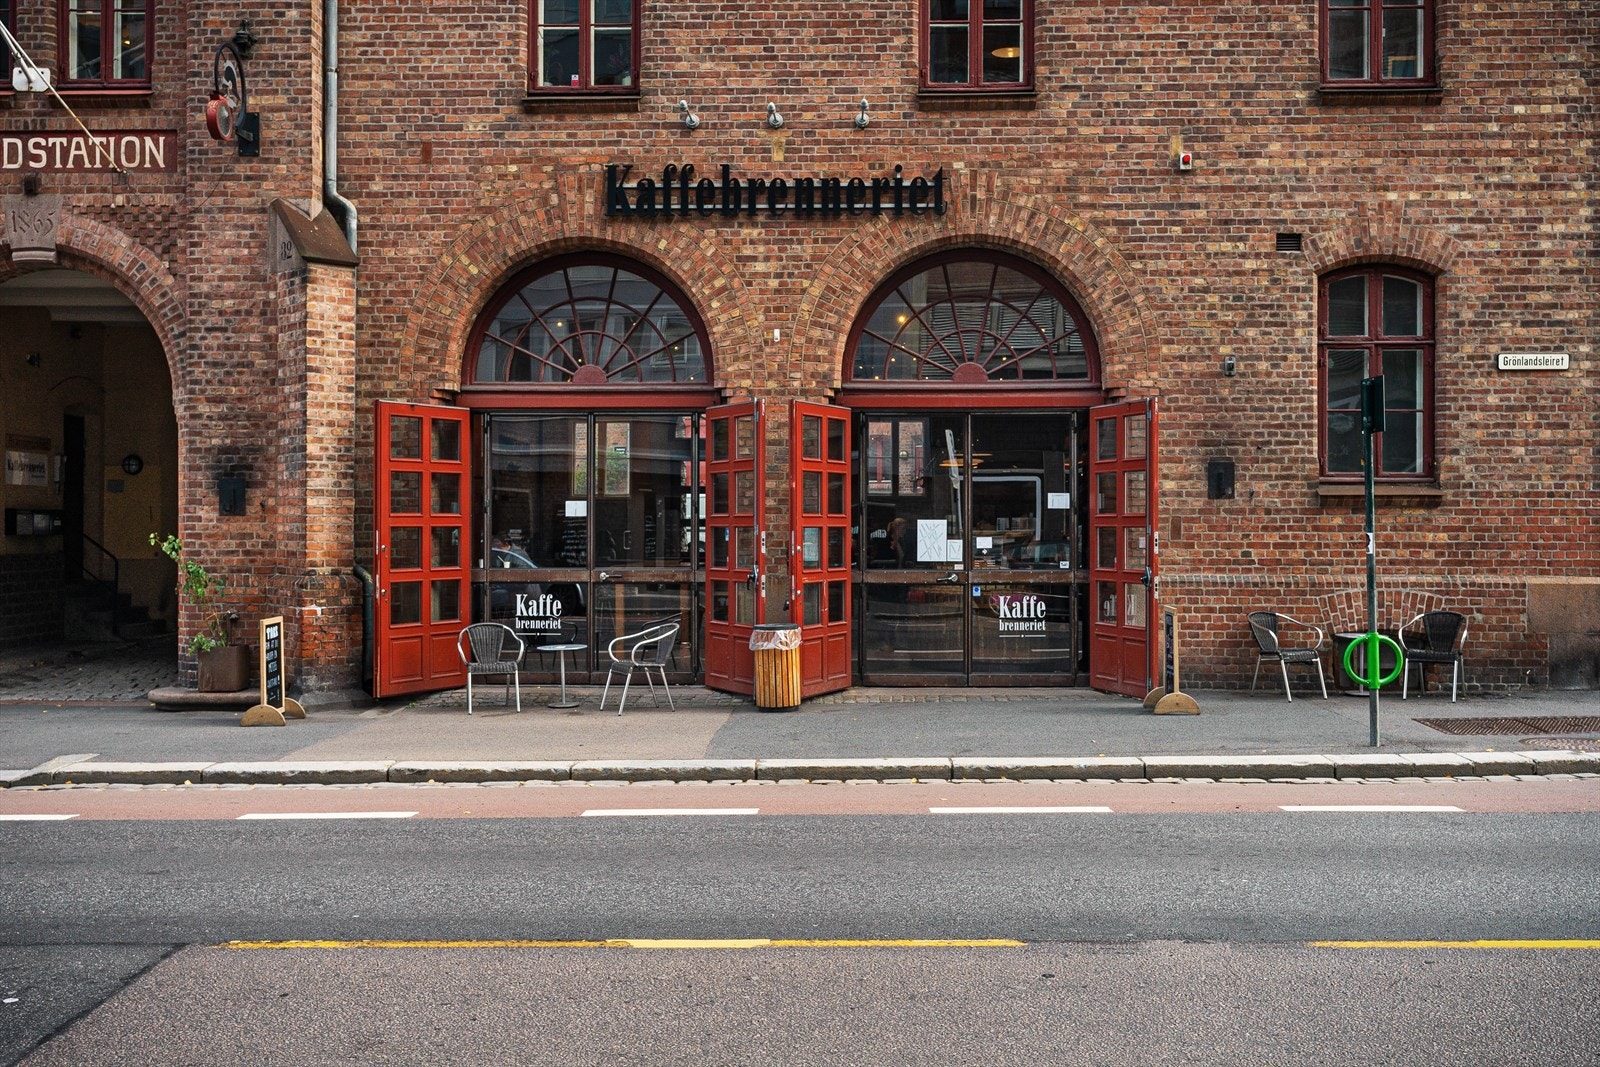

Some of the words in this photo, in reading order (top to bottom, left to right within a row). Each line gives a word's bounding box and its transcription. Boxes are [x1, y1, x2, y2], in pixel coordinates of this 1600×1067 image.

[2, 135, 166, 169] DSTATION
[605, 163, 948, 217] Kaffebrenneriet
[10, 210, 56, 238] 1865
[1503, 356, 1564, 366] Grönlandsleiret
[515, 593, 562, 617] Kaffe
[998, 595, 1046, 619] Kaffe
[515, 617, 562, 629] brenneriet
[999, 619, 1046, 631] brenneriet
